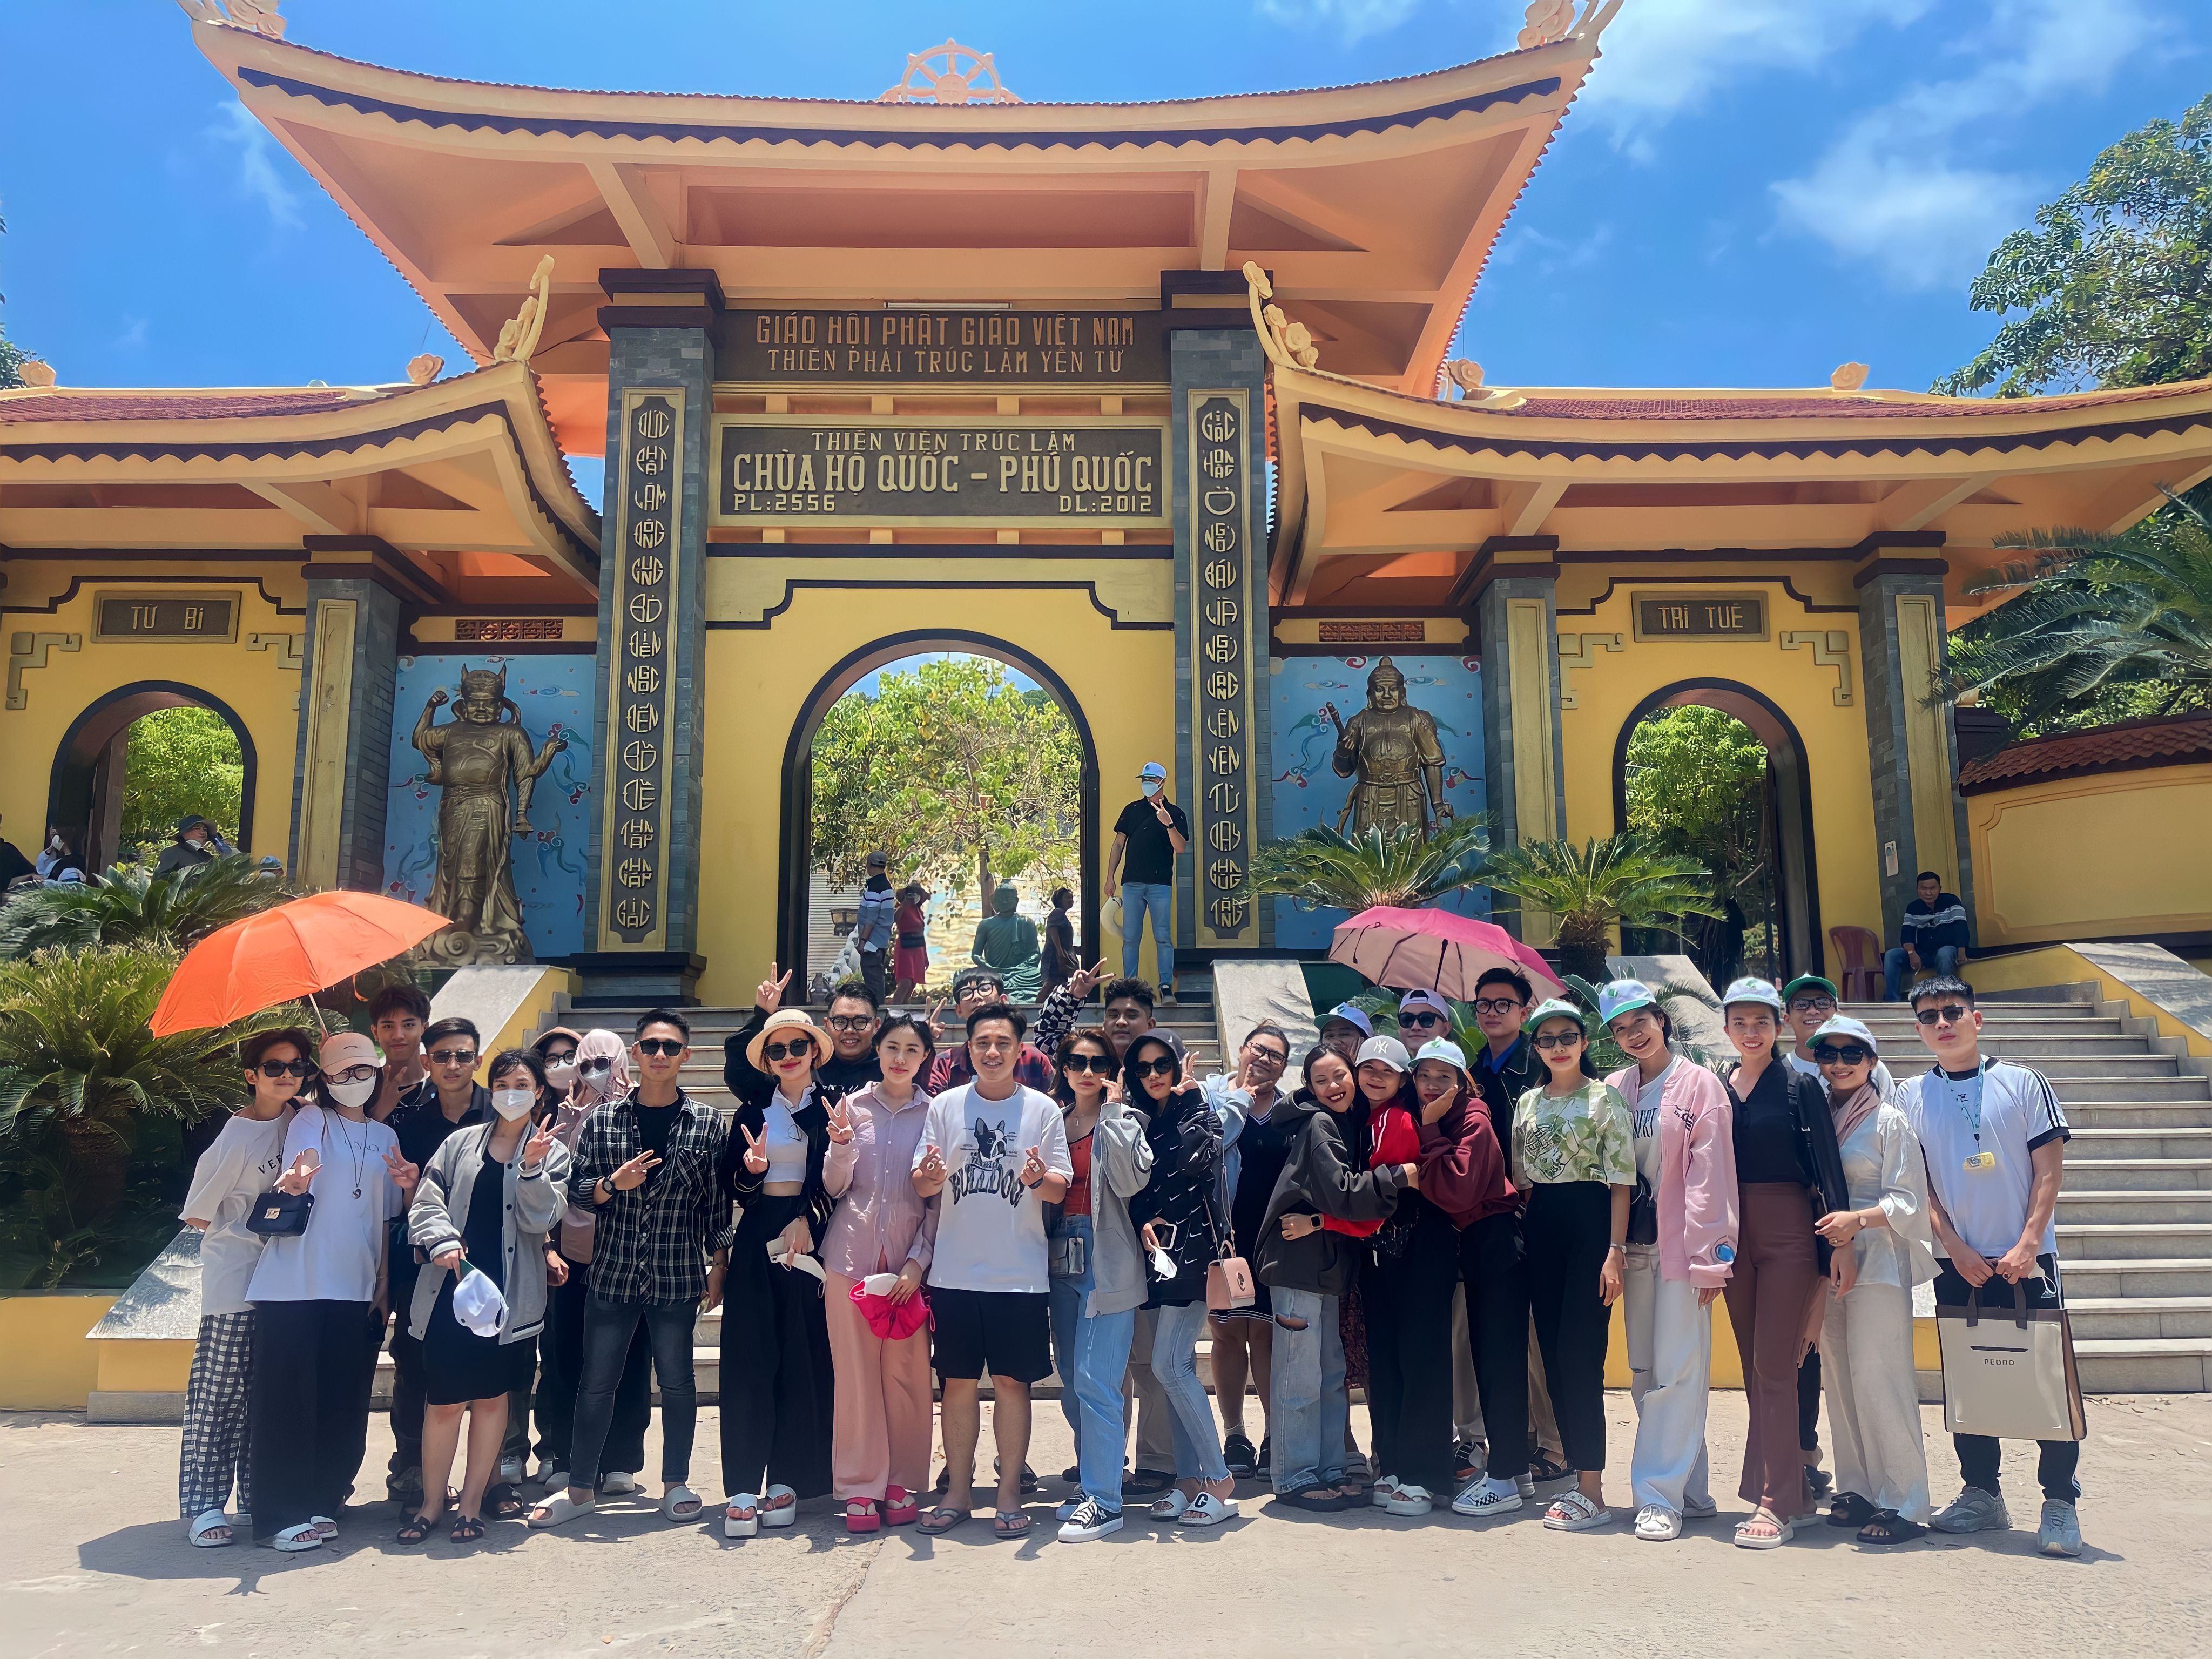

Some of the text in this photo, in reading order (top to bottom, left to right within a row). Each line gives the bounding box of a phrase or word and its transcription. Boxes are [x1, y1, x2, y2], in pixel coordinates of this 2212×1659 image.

[757, 312, 815, 344] GIÁO
[962, 313, 1020, 345] GIÁO
[1093, 317, 1133, 346] NAM
[915, 347, 973, 373] TRÚC
[960, 430, 1019, 451] TRÚC
[734, 449, 816, 491] CHÙA
[825, 452, 865, 495] HỘ
[878, 450, 959, 492] QUỐC
[999, 451, 1061, 493] PHÚ
[1071, 450, 1151, 493] QUỐC
[734, 494, 835, 511] PL:2556
[1059, 495, 1151, 512] DL:2012
